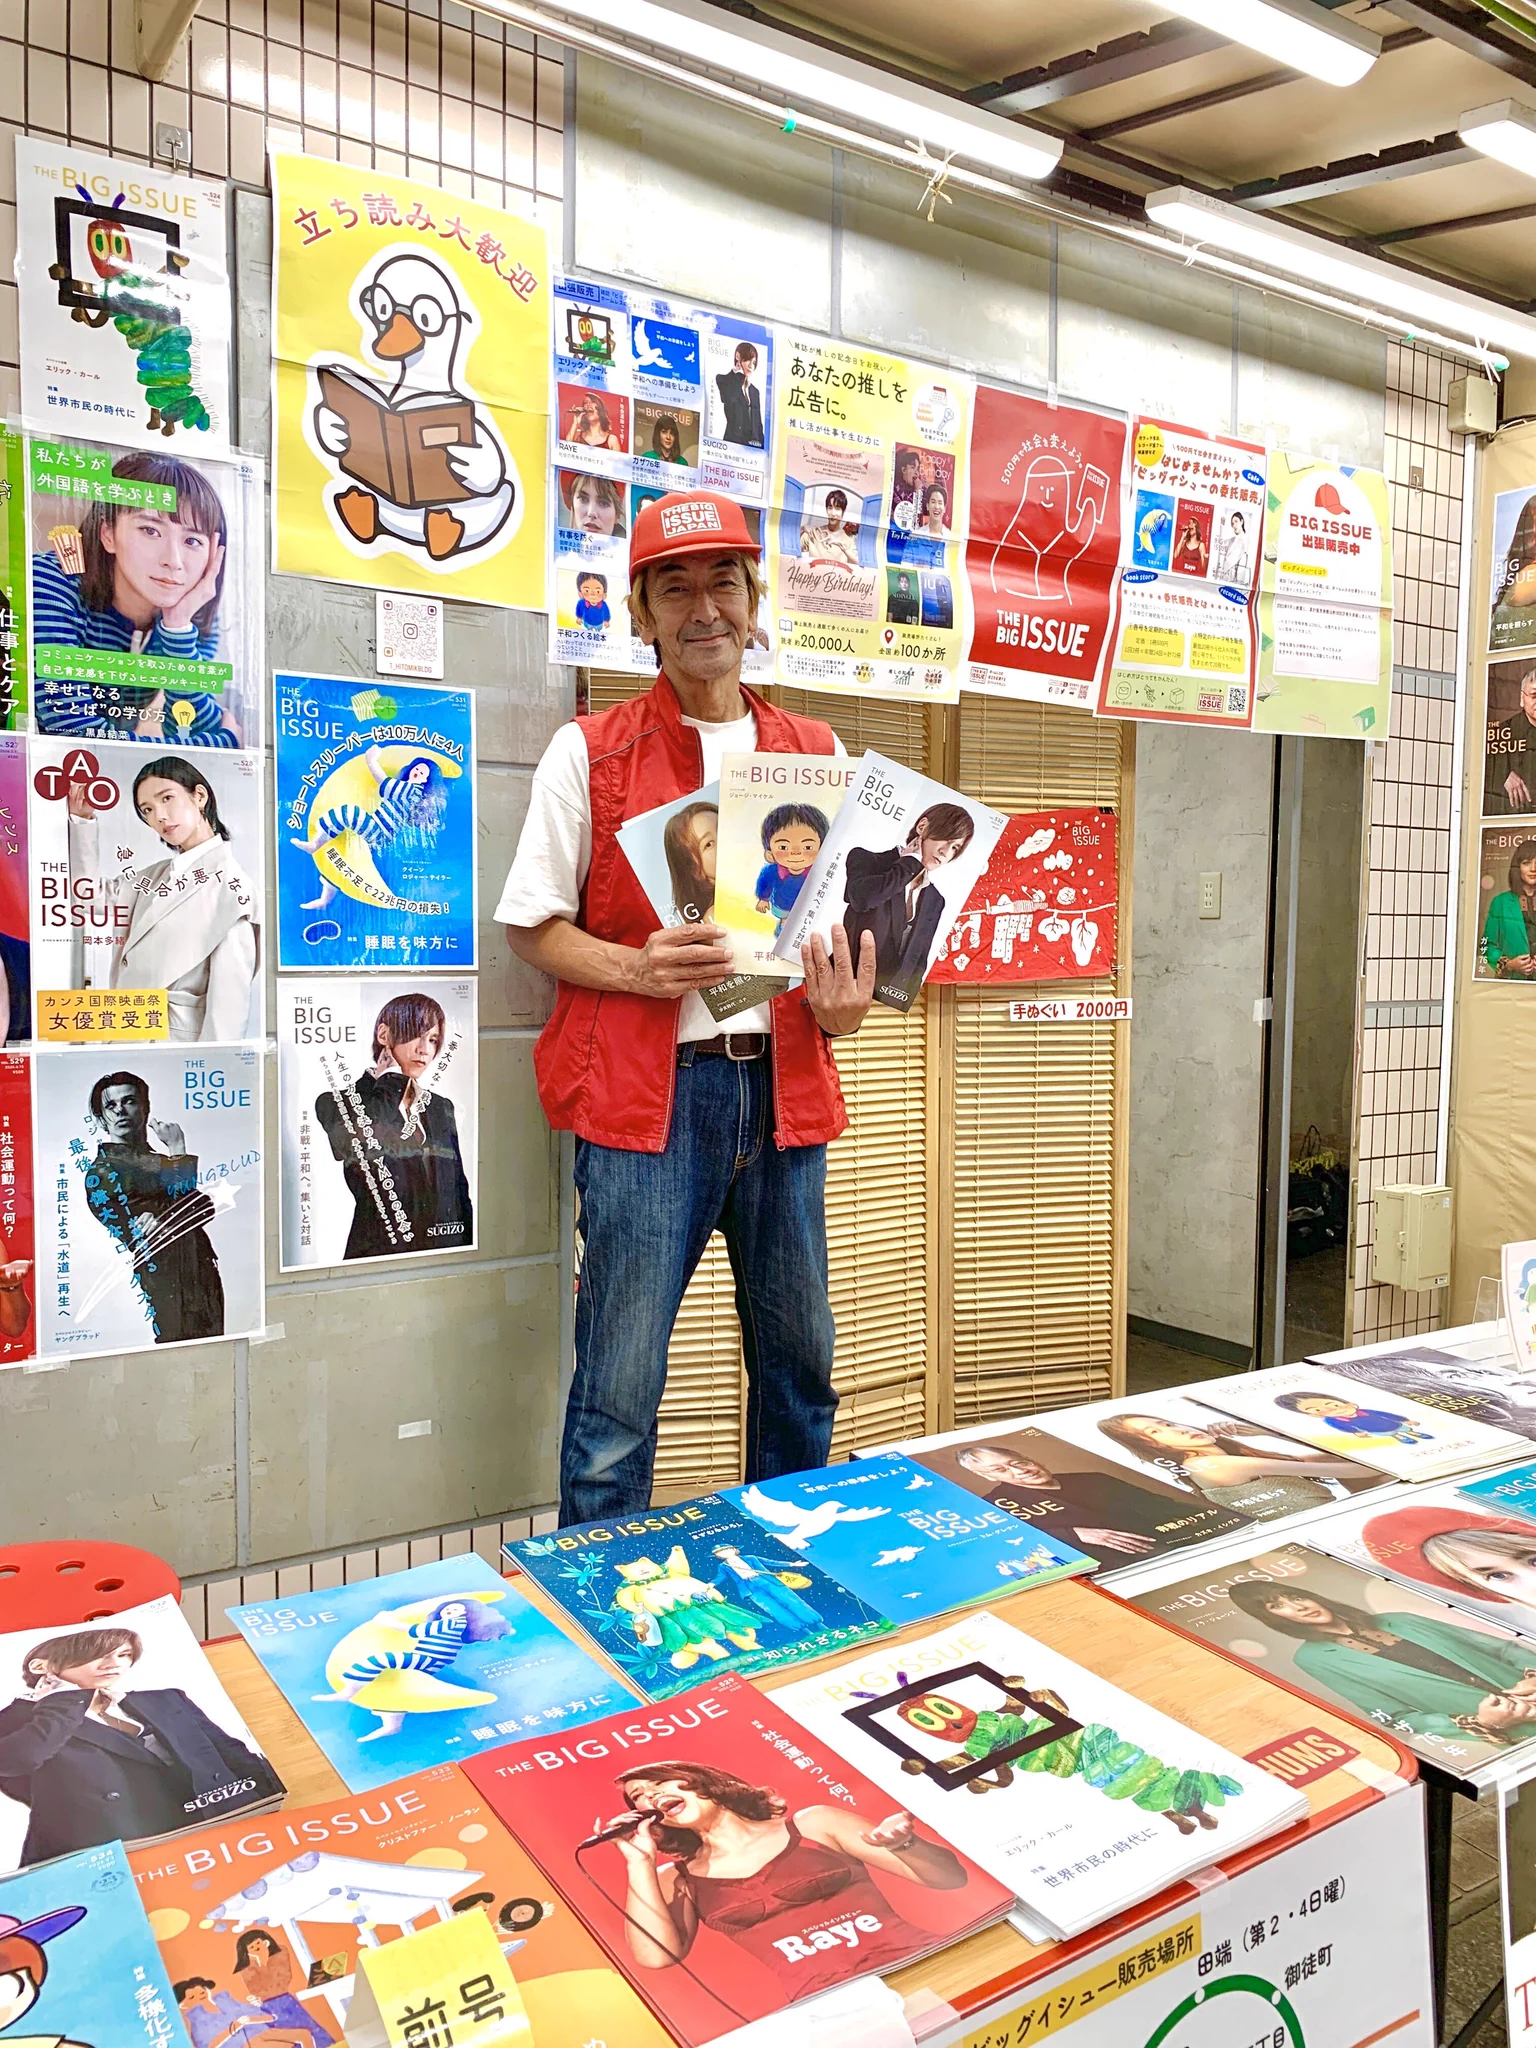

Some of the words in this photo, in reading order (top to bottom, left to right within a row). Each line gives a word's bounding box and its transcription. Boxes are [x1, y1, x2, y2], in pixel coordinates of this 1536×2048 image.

[33, 165, 58, 179] THE
[62, 167, 110, 197] BIG
[120, 181, 197, 219] ISSUE
[294, 192, 539, 303] 立ち読み大歓迎
[46, 364, 100, 380] エリック・カール
[791, 357, 908, 403] あなたの推しを
[632, 374, 696, 394] 平和への準備をしよう
[47, 394, 136, 419] 世界市民の時代に
[646, 407, 662, 418] BIG
[788, 386, 847, 420] 広告に。
[789, 419, 880, 446] 推し活が仕事を生む力に
[559, 442, 578, 453] RAYE
[703, 439, 728, 450] SUGIZO
[36, 447, 107, 471] 私たちが
[1001, 433, 1083, 485] 500円で社会を変えよう。
[1161, 454, 1240, 482] はじめませんか？
[704, 466, 719, 476] THE
[722, 468, 734, 479] BIG
[736, 471, 760, 483] ISSUE
[704, 477, 730, 488] JAPAN
[1247, 472, 1260, 483] Cafe
[36, 472, 174, 507] 外国語を学ぶとき
[664, 505, 689, 516] THE
[666, 511, 716, 528] ISSUE
[1194, 506, 1210, 514] ISSUE
[668, 522, 718, 535] JAPAN
[1289, 513, 1318, 532] BIG
[1322, 519, 1372, 540] ISSUE
[1302, 534, 1360, 556] 出張販売中
[1126, 572, 1139, 580] book
[1495, 558, 1520, 573] BIG
[787, 559, 822, 592] Happy
[823, 572, 875, 600] Birthday!
[1494, 570, 1534, 588] ISSUE
[1164, 593, 1208, 609] 委託販売とは
[1220, 588, 1235, 600] record
[996, 609, 1021, 628] THE
[1495, 619, 1534, 631] 平和を照らす
[557, 629, 606, 641] 平和つくる絵本
[995, 626, 1019, 647] BIG
[1021, 614, 1090, 658] ISSUE
[0, 608, 19, 715] 仕事とケア
[42, 649, 227, 677] コミュニケーションを取るための言葉が
[44, 681, 121, 700] 幸せになる
[281, 686, 300, 698] THE
[44, 698, 167, 723] “ことば”の学び方
[281, 700, 319, 718] BIG
[1199, 699, 1222, 709] ISSUE
[85, 727, 129, 740] 黒島結菜
[281, 719, 344, 740] ISSUE
[1487, 728, 1511, 740] BIG
[1486, 738, 1527, 755] ISSUE
[288, 726, 465, 829] ショートスリーパーは10万人に4人
[730, 769, 747, 779] THE
[751, 766, 787, 785] BIG
[794, 768, 856, 788] ISSUE
[871, 765, 886, 779] THE
[728, 791, 774, 800] ジョージ・マイケル
[864, 775, 895, 798] BIG
[856, 792, 906, 822] ISSUE
[1072, 826, 1091, 836] BIG
[1073, 835, 1099, 845] ISSUE
[1499, 835, 1523, 848] BIG
[41, 862, 67, 873] THE
[116, 845, 250, 906] 急に具合が悪くなる
[41, 877, 95, 900] BIG
[325, 847, 451, 916] 睡眠不足で22兆円の損失！
[41, 905, 129, 927] ISSUE
[791, 861, 838, 950] 非戦・平和へ。集いと対話
[82, 935, 125, 945] 岡本多緒
[365, 934, 459, 951] 睡眠を味方に
[1478, 936, 1488, 974] ガザ76年
[45, 995, 161, 1007] カンヌ国際映画祭
[294, 996, 313, 1005] THE
[879, 985, 909, 1002] SUGIZO
[49, 1010, 163, 1031] 女優賞受賞
[294, 1007, 332, 1024] BIG
[1013, 1003, 1066, 1019] 手ぬぐい
[1076, 1001, 1127, 1017] 2000円
[294, 1026, 356, 1044] ISSUE
[184, 1060, 205, 1068] THE
[185, 1071, 225, 1089] BIG
[185, 1089, 251, 1110] ISSUE
[1, 1132, 14, 1239] 社会運動って何？
[427, 1224, 465, 1237] SUGIZO
[57, 1178, 71, 1317] 市民による「水道」再生へ
[1495, 1479, 1534, 1497] BIG
[897, 1509, 923, 1519] THE
[908, 1510, 960, 1529] BIG
[555, 1527, 616, 1552] BIG
[617, 1505, 707, 1539] ISSUE
[924, 1511, 1008, 1541] ISSUE
[1158, 1600, 1187, 1615] THE
[1180, 1582, 1229, 1610] BIG
[246, 1608, 297, 1627] BIG
[251, 1610, 339, 1638] ISSUE
[761, 1620, 881, 1661] 知られざるネコ
[823, 1671, 888, 1701] BIG
[888, 1633, 988, 1679] ISSUE
[471, 1694, 611, 1742] 睡眠を味方に
[495, 1761, 534, 1778] THE
[533, 1738, 611, 1772] BIG
[611, 1698, 730, 1750] ISSUE
[1370, 1708, 1468, 1758] ガザ76年
[761, 1728, 857, 1807] 社会運動って何？
[183, 1780, 257, 1813] SUGIZO
[134, 1864, 180, 1884] THE
[184, 1831, 275, 1874] BIG
[288, 1789, 426, 1846] ISSUE
[377, 1806, 481, 1850] クリストファー・ノーラン
[1004, 1821, 1074, 1858] エリック・カール
[1042, 1828, 1159, 1889] 世界市民の時代に
[771, 1911, 884, 1964] Raye
[1284, 1943, 1334, 1992] 御徒町
